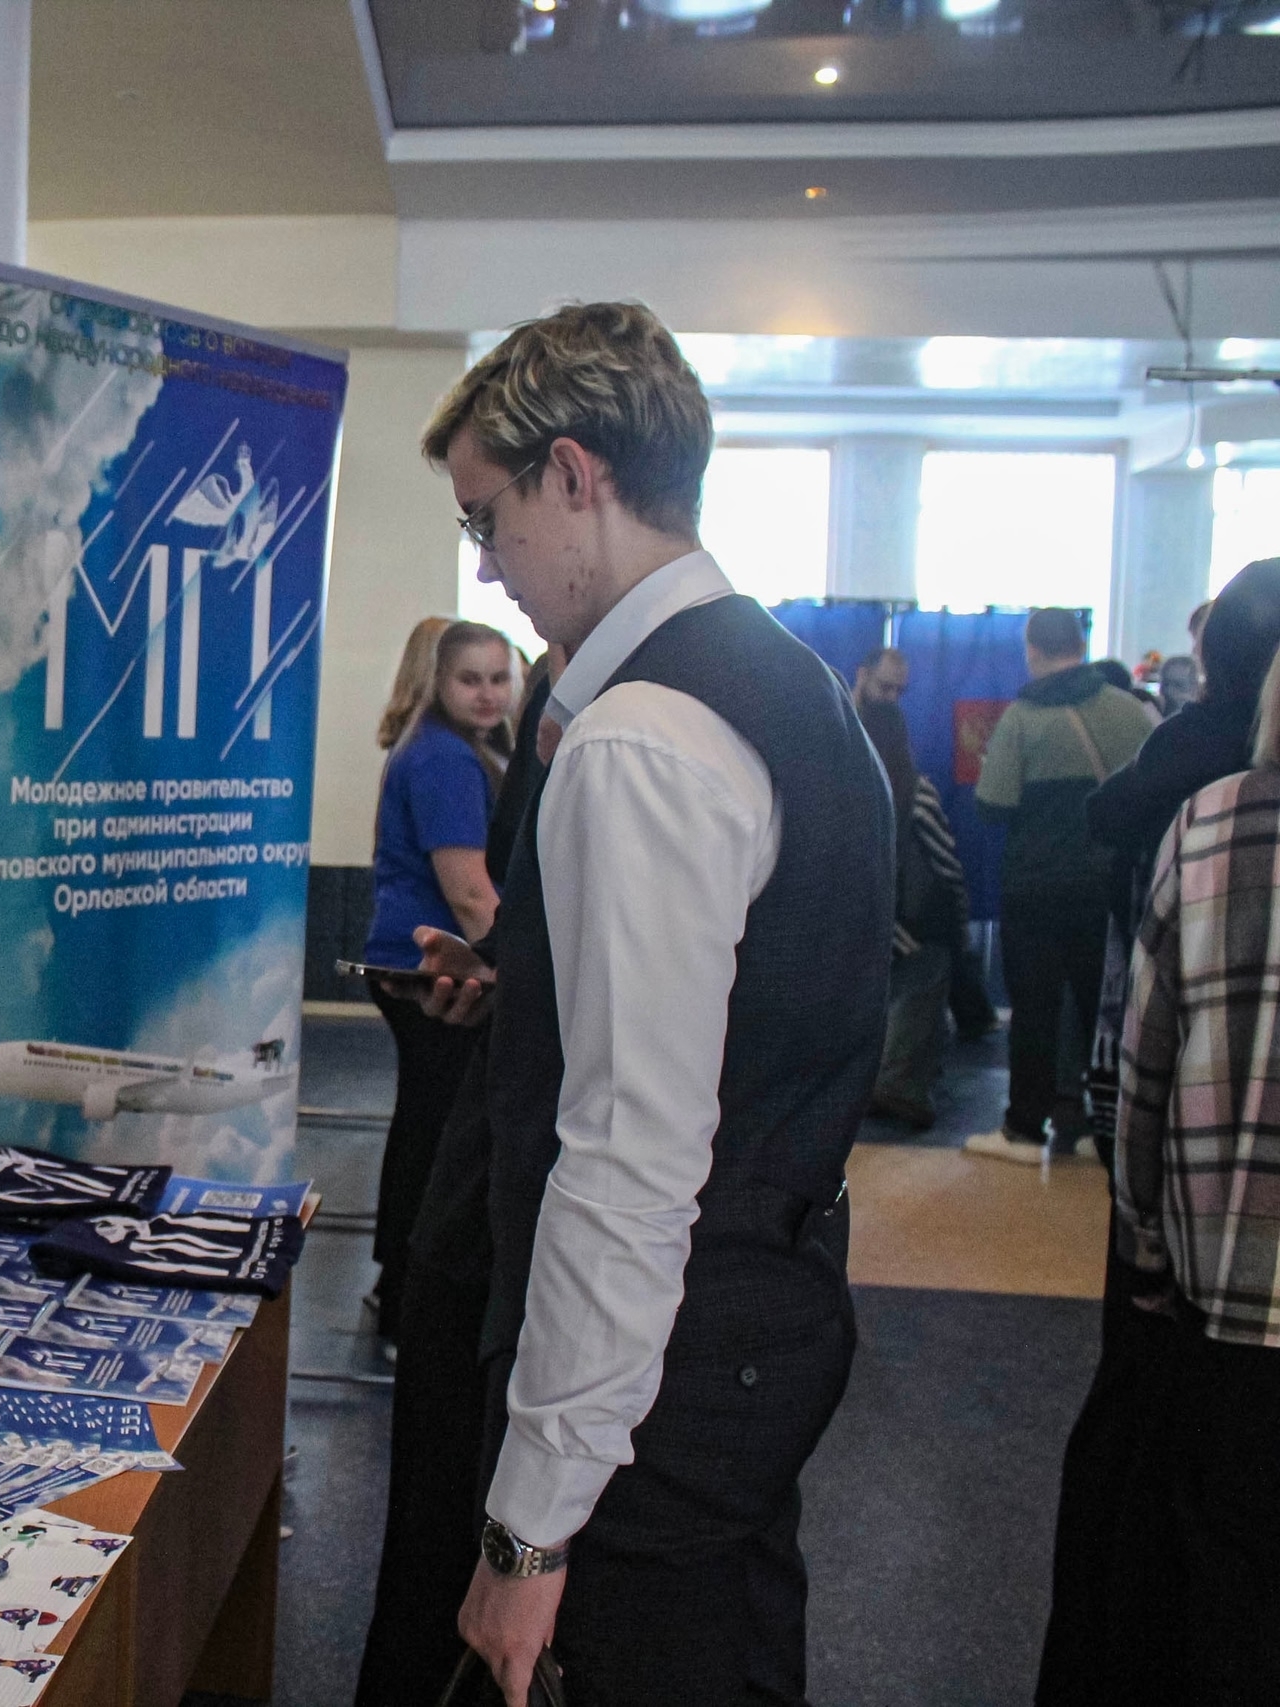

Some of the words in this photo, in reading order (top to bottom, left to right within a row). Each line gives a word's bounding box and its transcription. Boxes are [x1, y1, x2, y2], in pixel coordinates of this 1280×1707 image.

[10, 775, 147, 805] Молодежное
[152, 778, 293, 805] правительство
[54, 818, 96, 845] при
[103, 811, 253, 839] администрации
[102, 847, 258, 877] муниципального
[54, 879, 167, 918] Орловской
[173, 876, 247, 903] области
